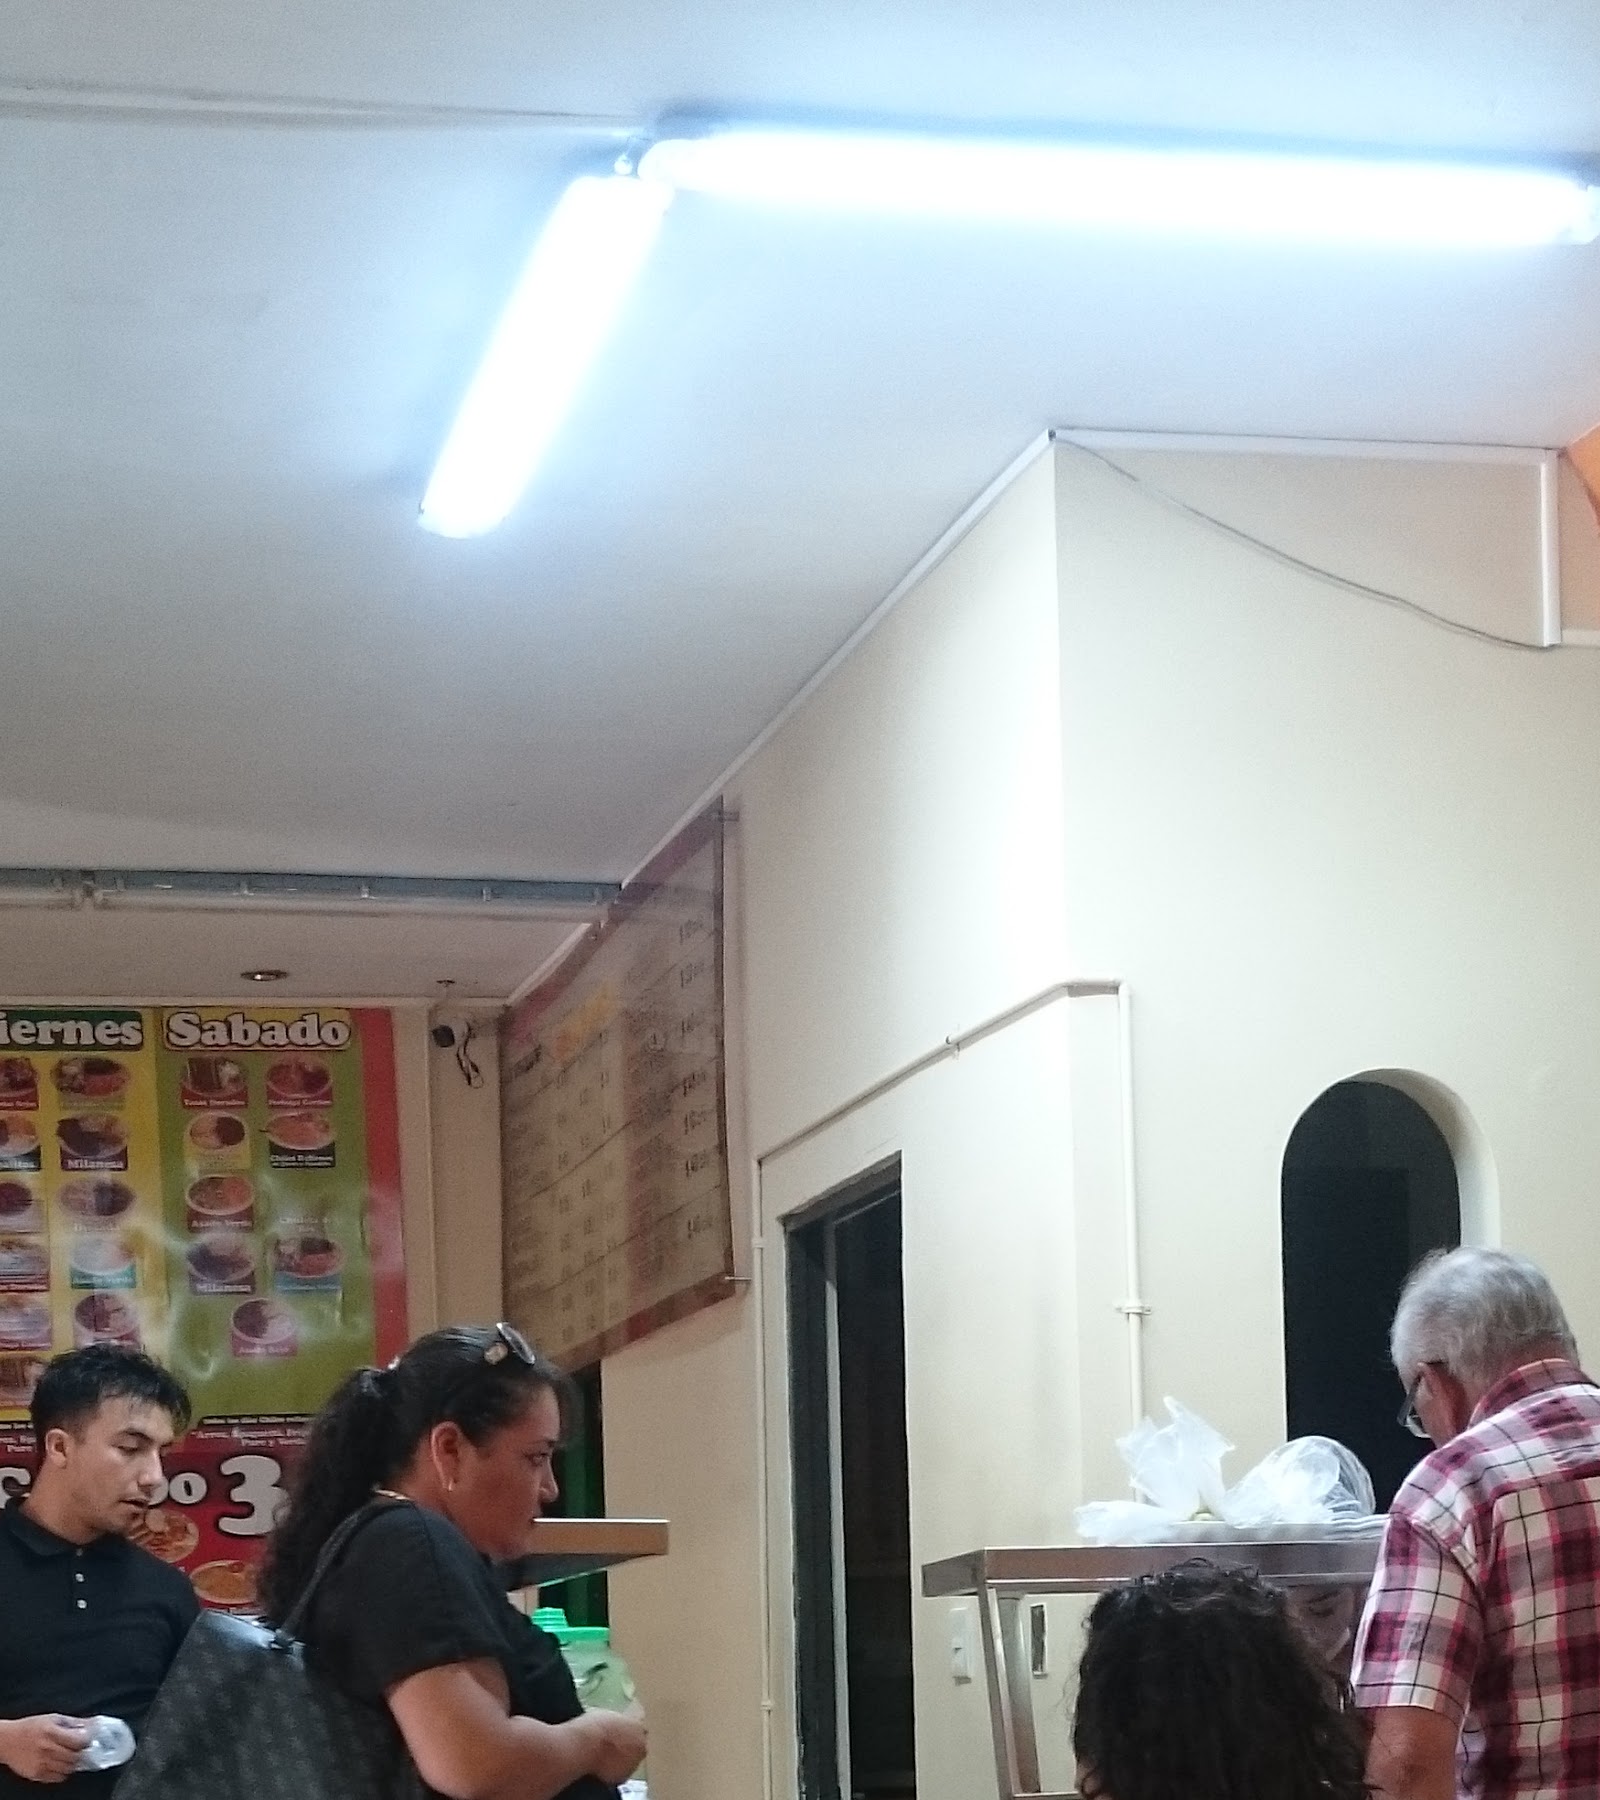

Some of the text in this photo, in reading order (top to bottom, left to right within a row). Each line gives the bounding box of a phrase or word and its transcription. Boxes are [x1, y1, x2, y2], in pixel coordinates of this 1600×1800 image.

[168, 1012, 350, 1046] Sabado
[67, 1160, 123, 1168] Milanesa
[219, 1455, 290, 1536] 3
